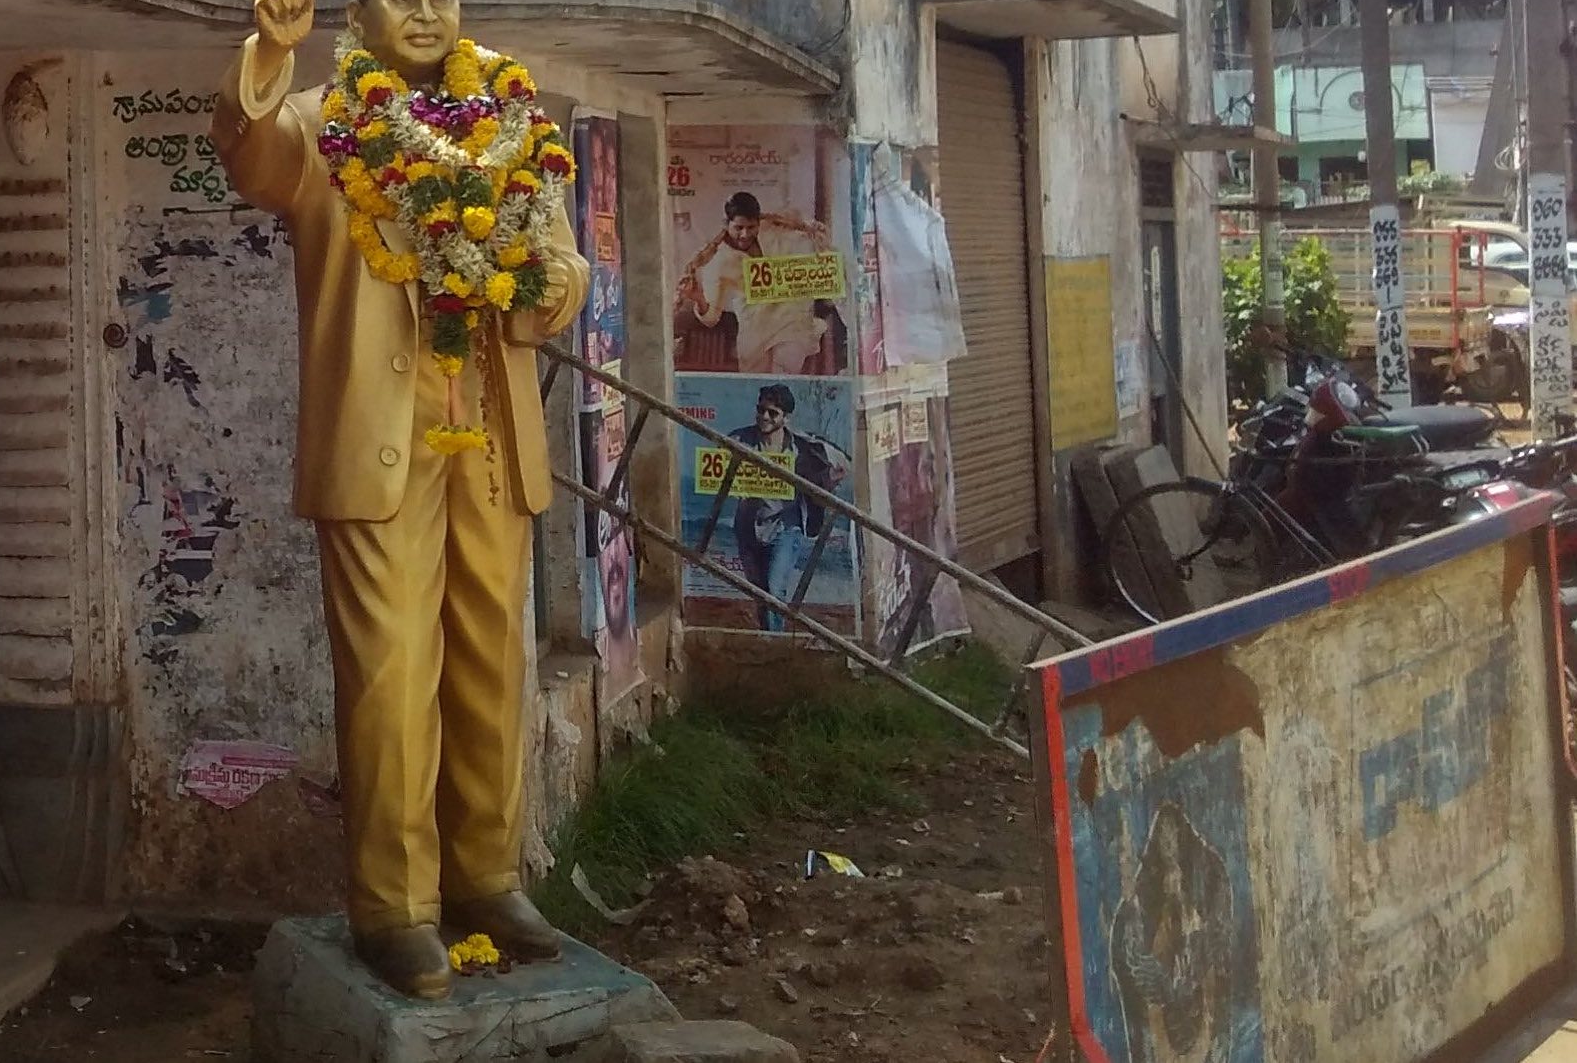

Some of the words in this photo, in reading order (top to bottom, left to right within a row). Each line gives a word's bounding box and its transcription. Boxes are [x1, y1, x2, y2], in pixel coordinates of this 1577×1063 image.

[668, 166, 690, 187] 26
[750, 262, 772, 287] 26
[703, 454, 723, 478] 26
